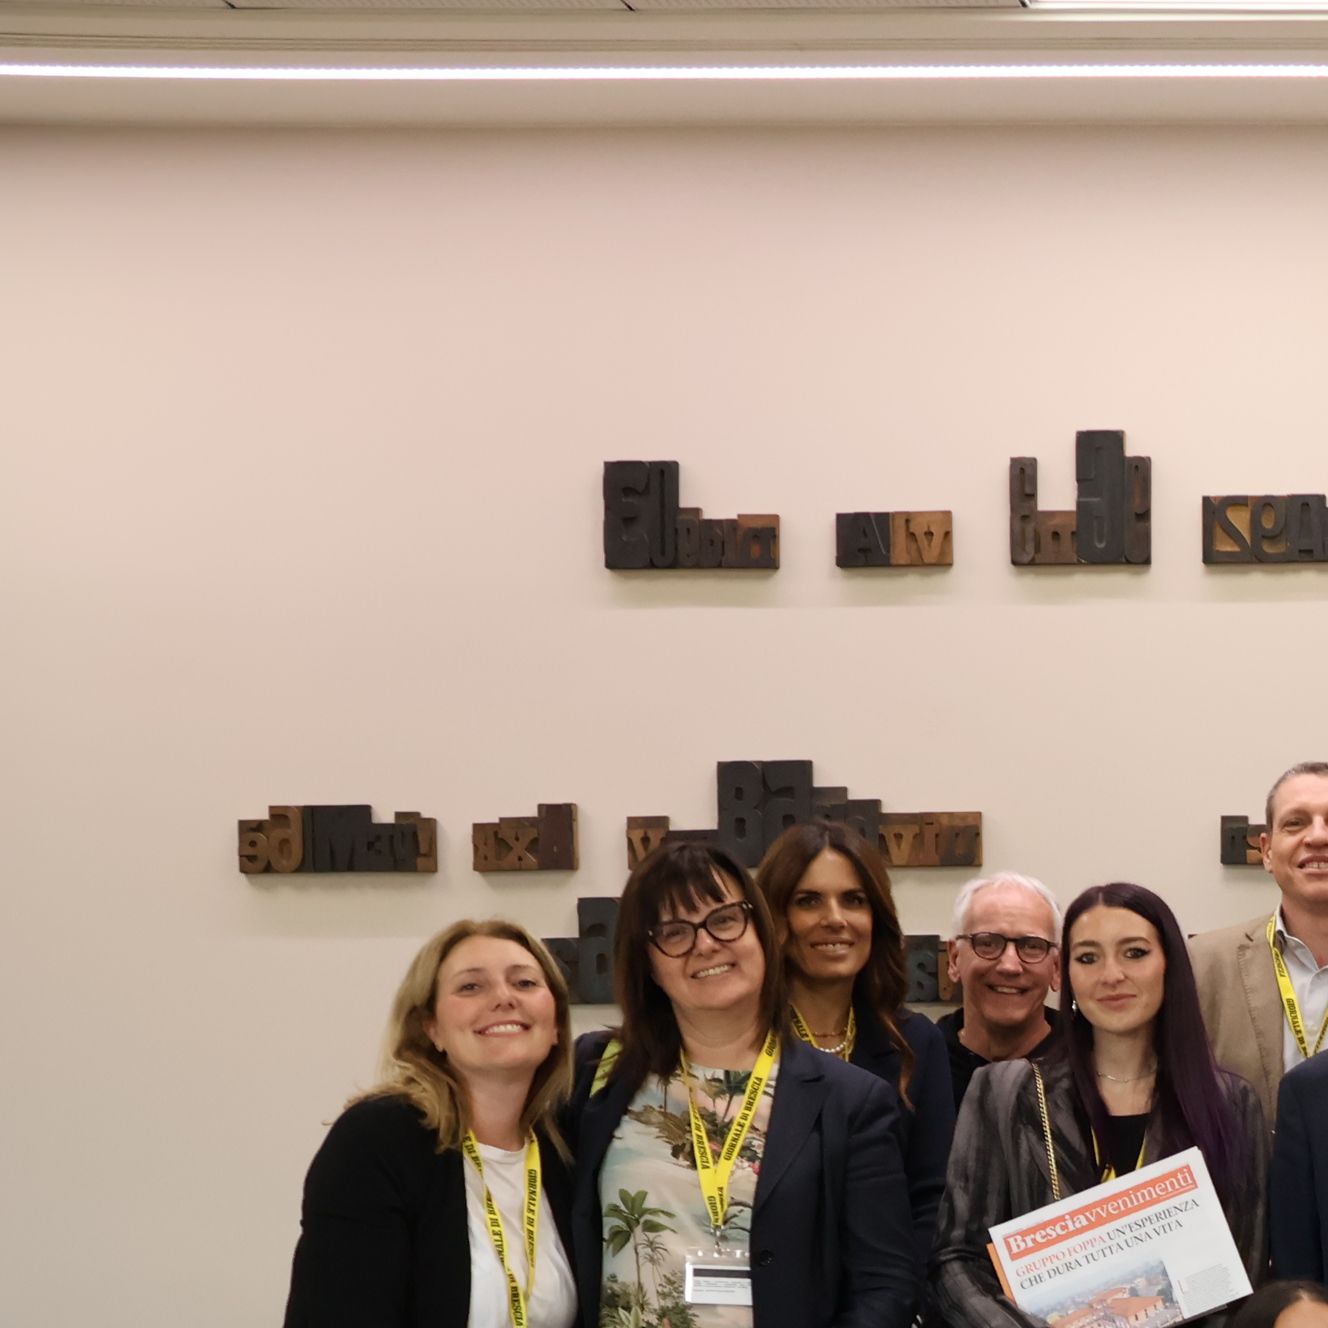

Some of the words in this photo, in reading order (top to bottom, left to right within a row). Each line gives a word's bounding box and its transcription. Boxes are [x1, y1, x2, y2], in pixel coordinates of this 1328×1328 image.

[1286, 998, 1302, 1035] GIORNALE
[723, 1122, 745, 1161] GIORNALE
[744, 1076, 763, 1110] BRESCIA
[1008, 1168, 1193, 1255] Bresciavvenimenti
[1015, 1249, 1069, 1278] GRUPPO
[1066, 1236, 1107, 1261] FOPPA
[1106, 1198, 1200, 1241] UN'ESPERIENZA
[1020, 1273, 1047, 1291] CHE
[1046, 1258, 1084, 1280] DURA
[1082, 1242, 1124, 1268] TUTTA
[1125, 1232, 1154, 1251] UNA
[1154, 1220, 1184, 1240] VITA
